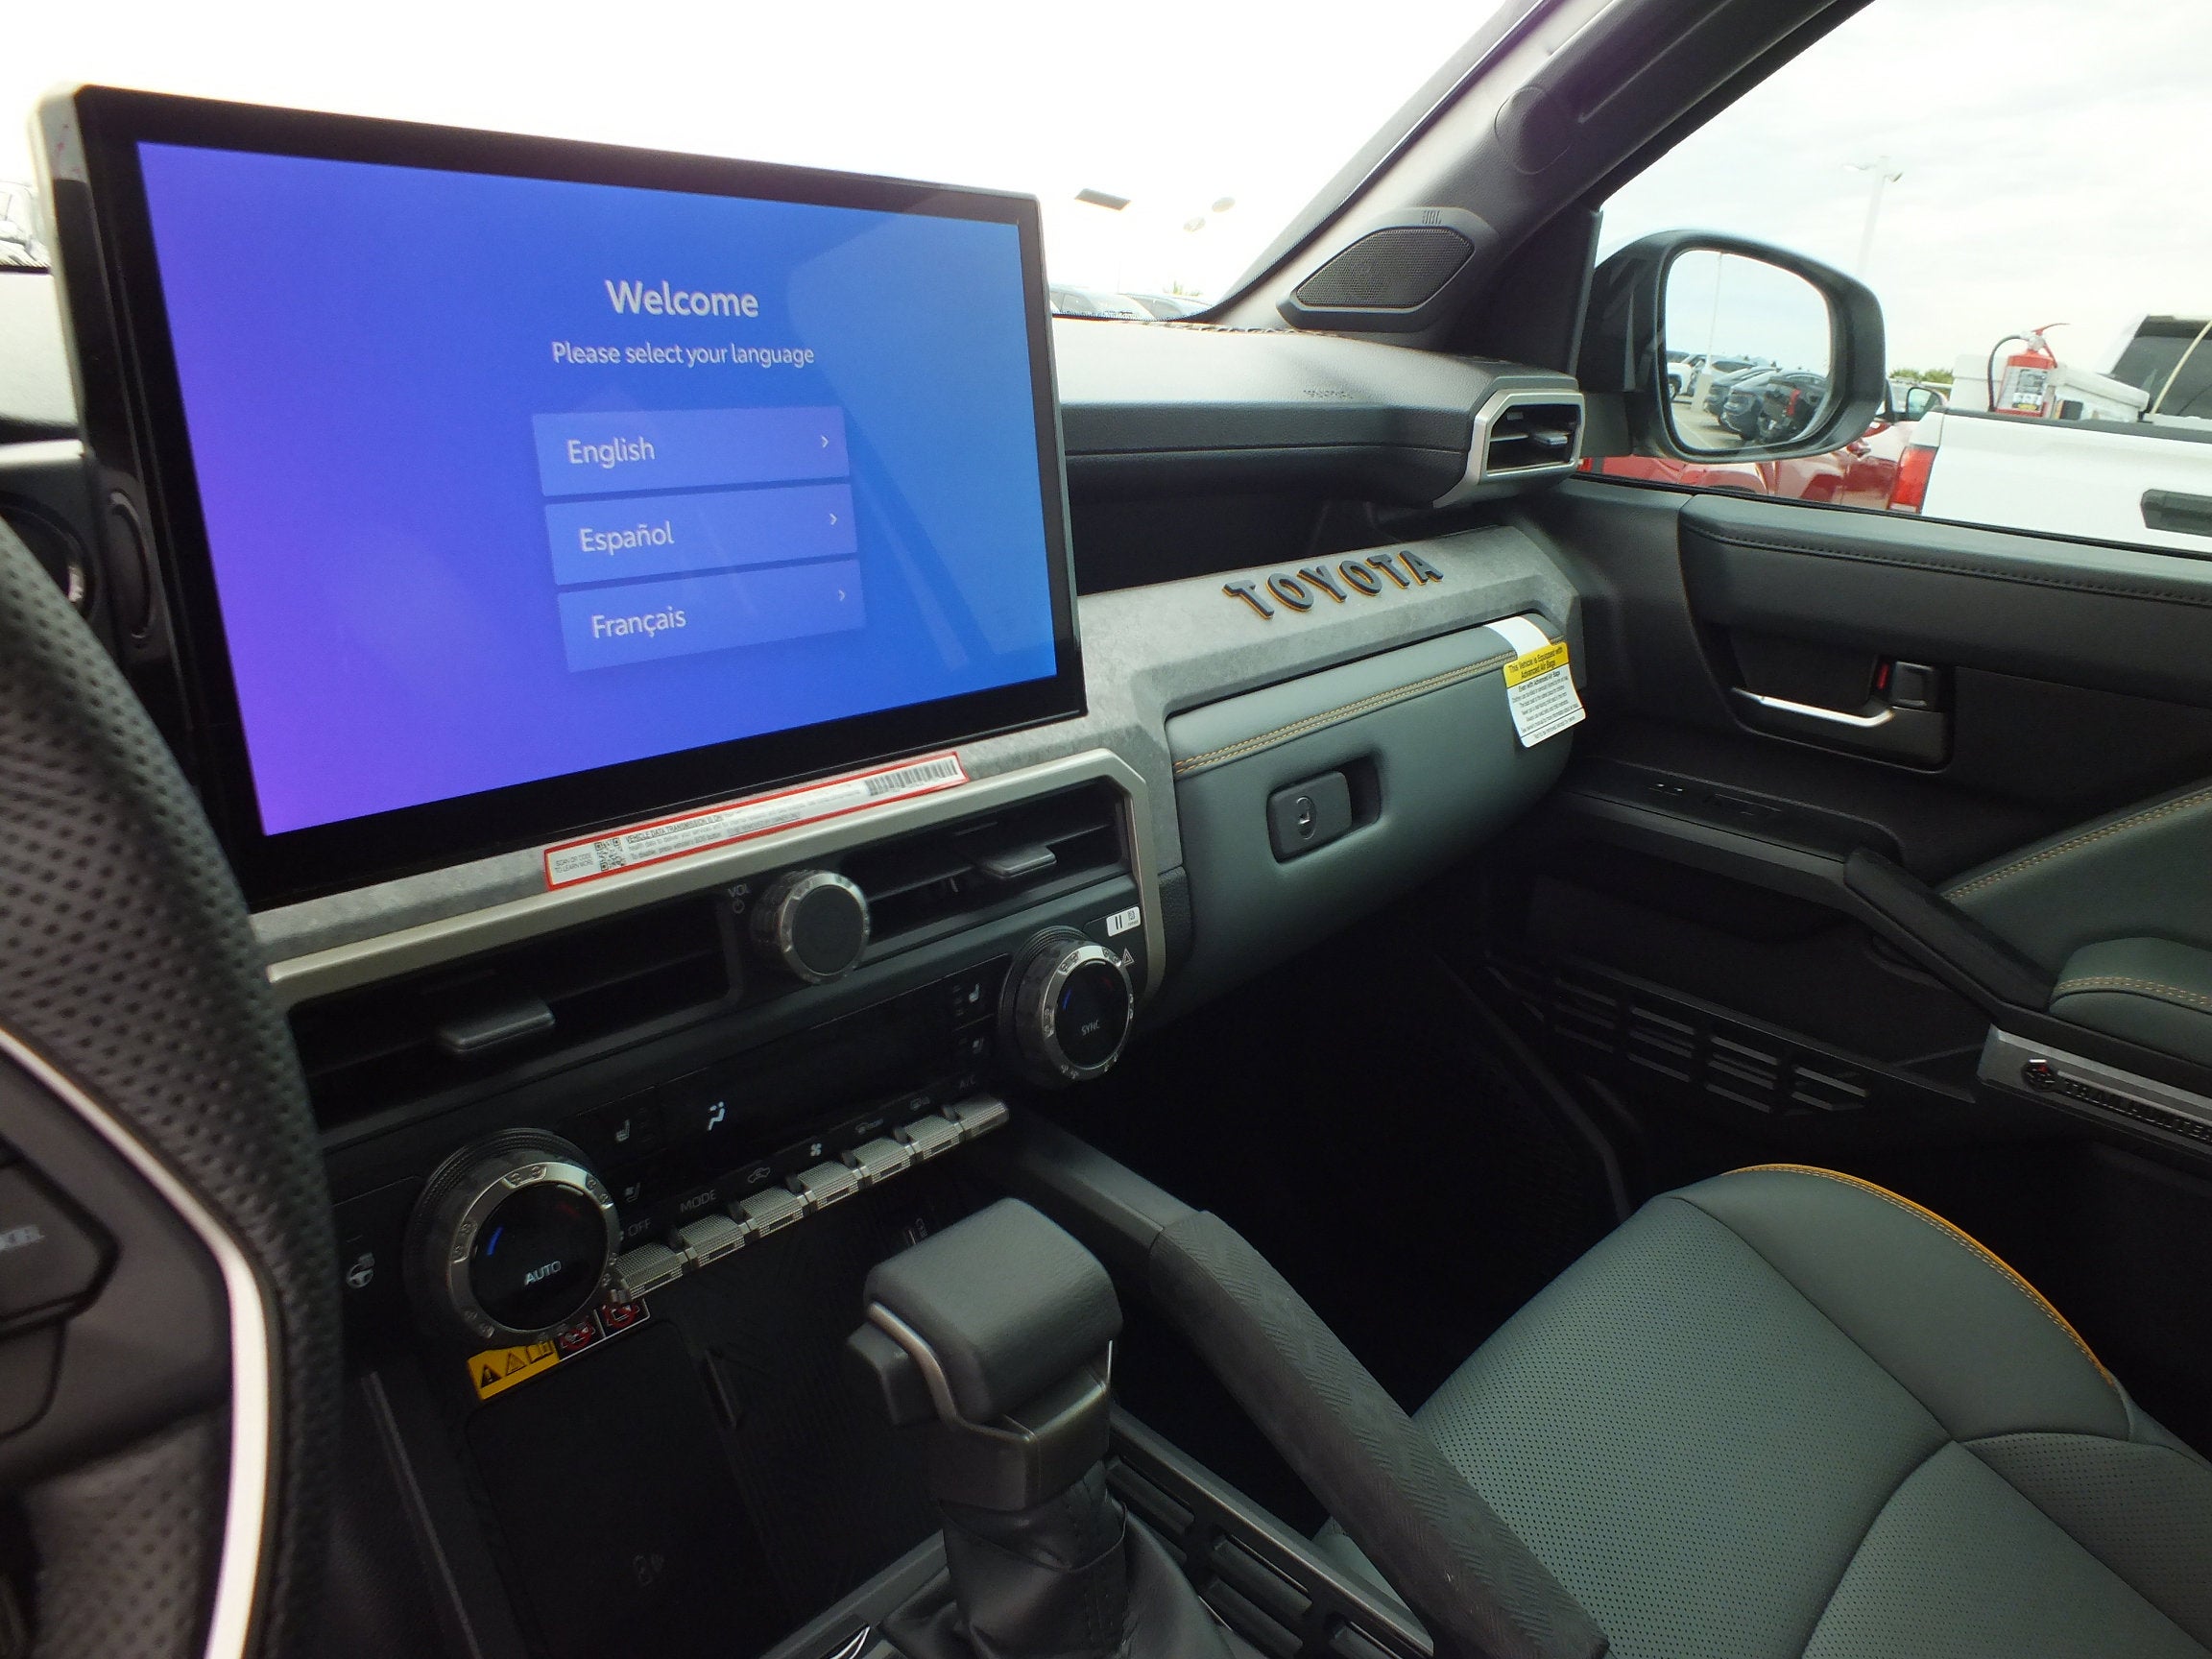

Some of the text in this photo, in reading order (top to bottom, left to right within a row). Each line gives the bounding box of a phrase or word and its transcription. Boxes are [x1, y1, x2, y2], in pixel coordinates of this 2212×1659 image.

[605, 279, 759, 318] Welcome
[552, 341, 815, 369] Please select your language
[567, 436, 656, 469] English
[580, 520, 675, 556] Español
[1222, 550, 1444, 619] TOYOTA
[591, 605, 687, 638] Français
[627, 830, 651, 844] VEHICLE
[651, 827, 666, 838] DATA
[727, 883, 751, 898] VOL
[1081, 1019, 1101, 1036] SYNC
[680, 1190, 717, 1213] MODE
[627, 1217, 652, 1238] OFF
[524, 1261, 562, 1286] AUTO
